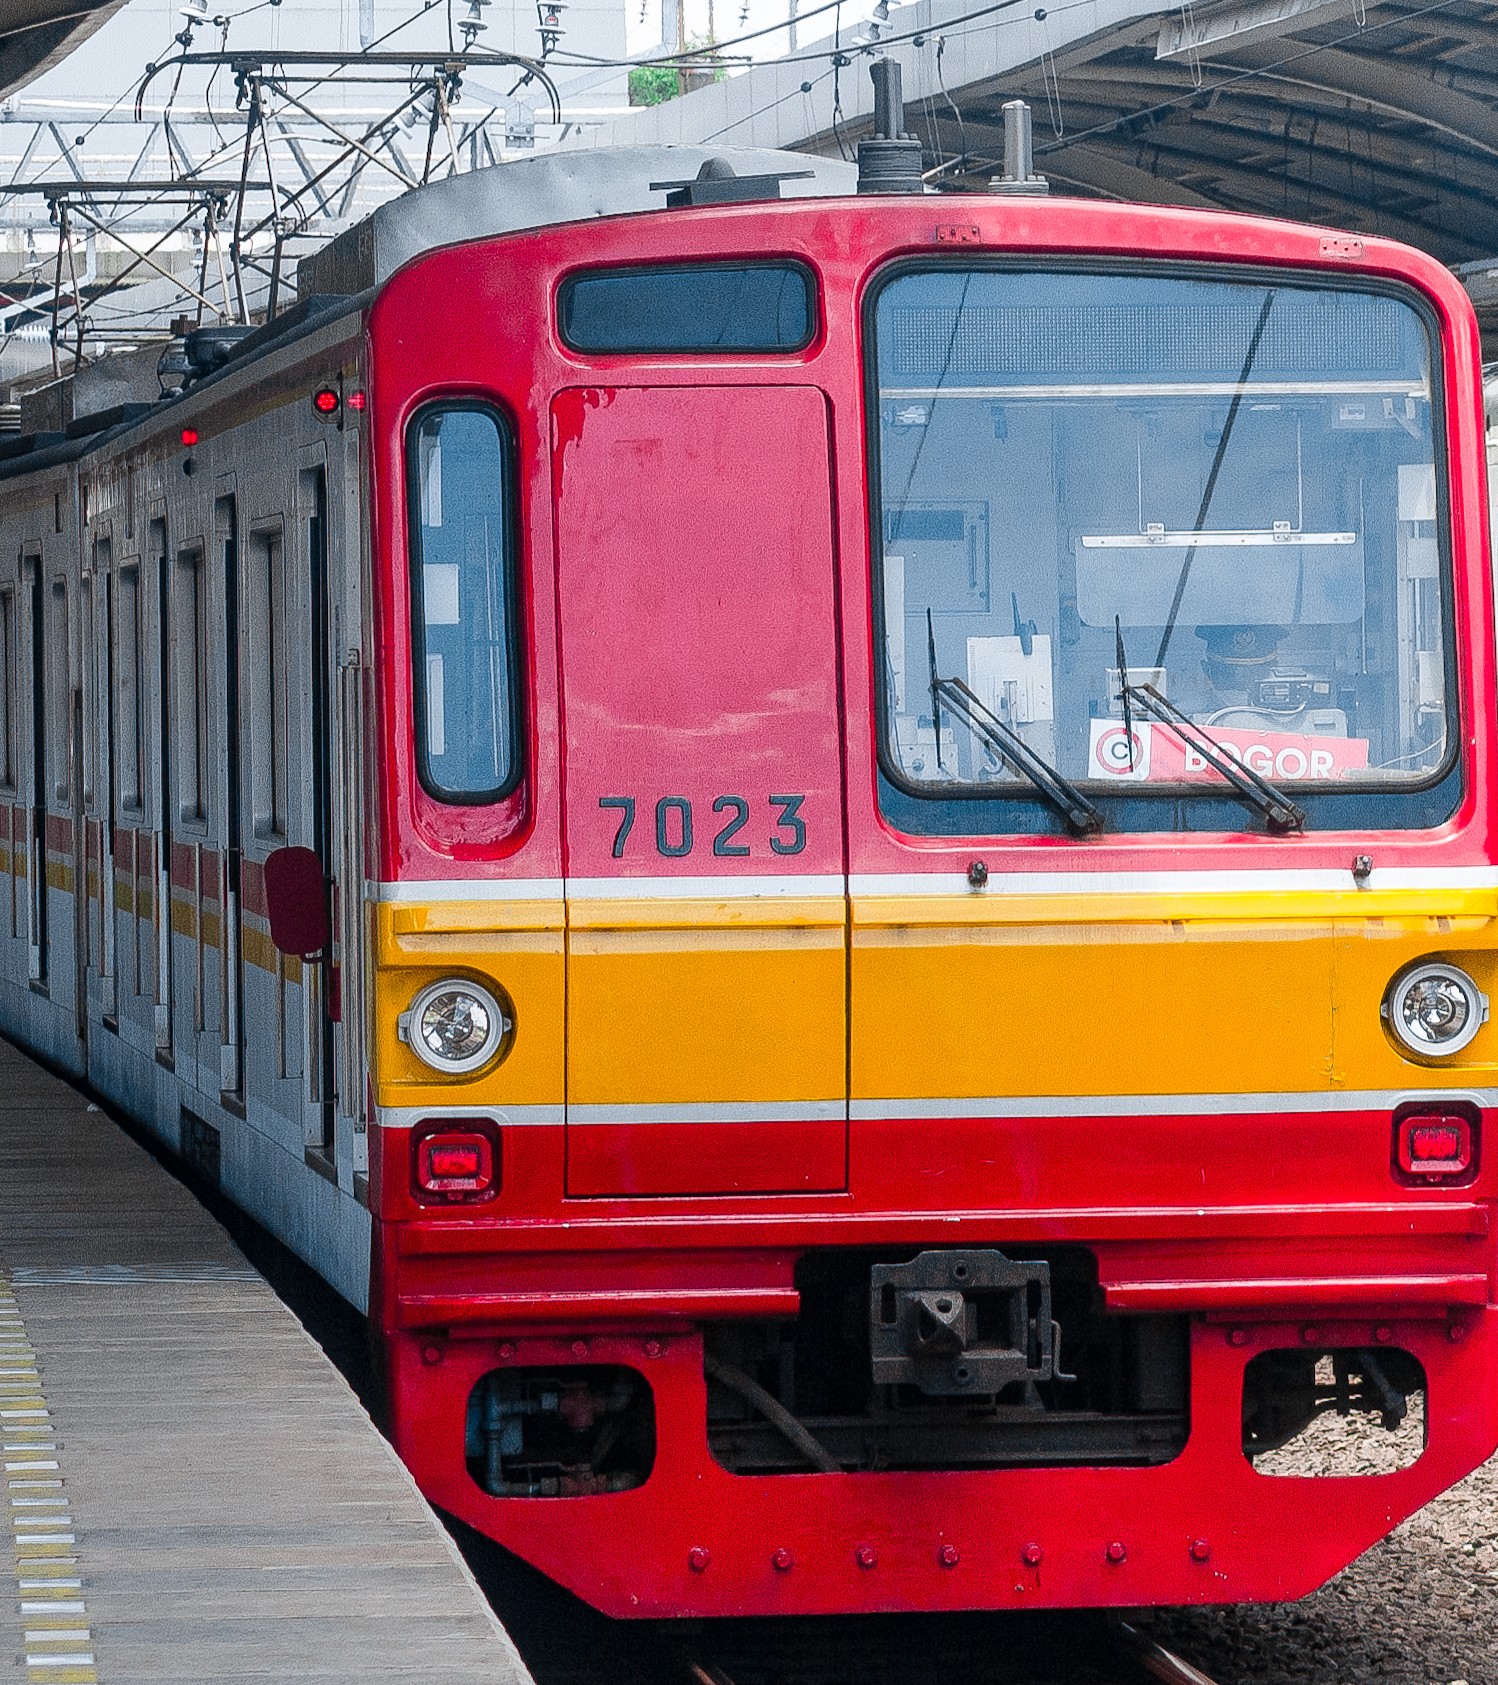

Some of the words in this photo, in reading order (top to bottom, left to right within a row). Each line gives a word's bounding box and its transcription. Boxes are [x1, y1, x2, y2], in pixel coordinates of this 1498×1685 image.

[1111, 741, 1129, 760] C
[1184, 739, 1335, 779] BOGOR
[599, 793, 807, 859] 7023
